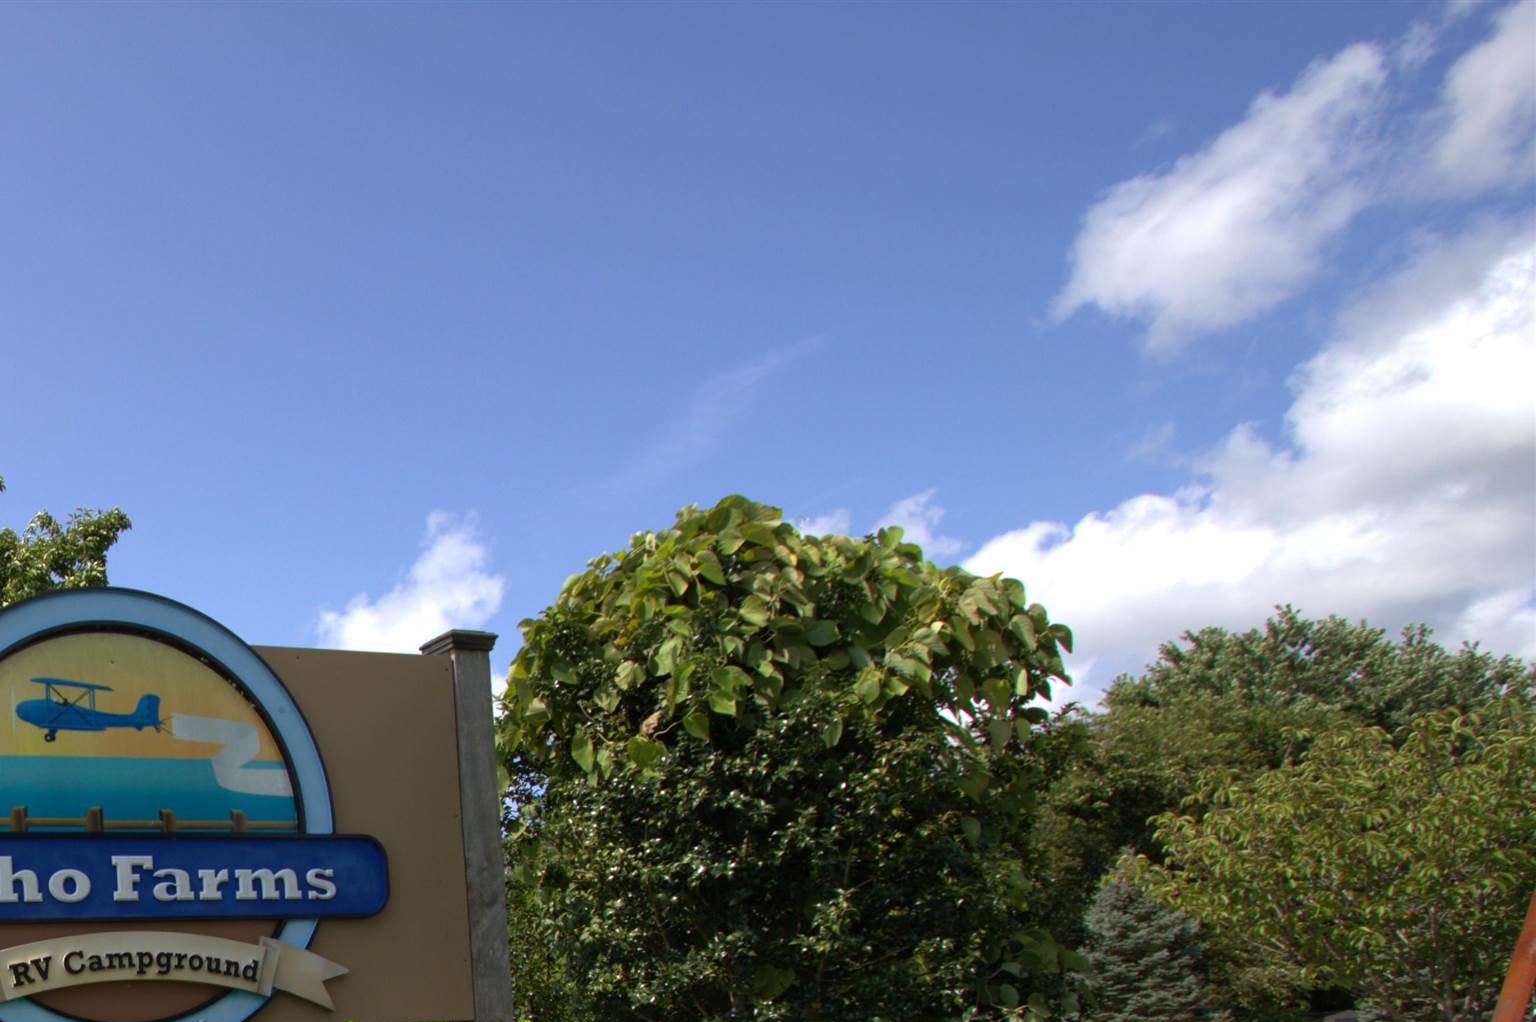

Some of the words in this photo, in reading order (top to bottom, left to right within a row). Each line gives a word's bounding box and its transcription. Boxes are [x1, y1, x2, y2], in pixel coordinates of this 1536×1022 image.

[111, 855, 338, 902] Farms
[9, 956, 52, 988] RV
[63, 949, 260, 982] Campground
